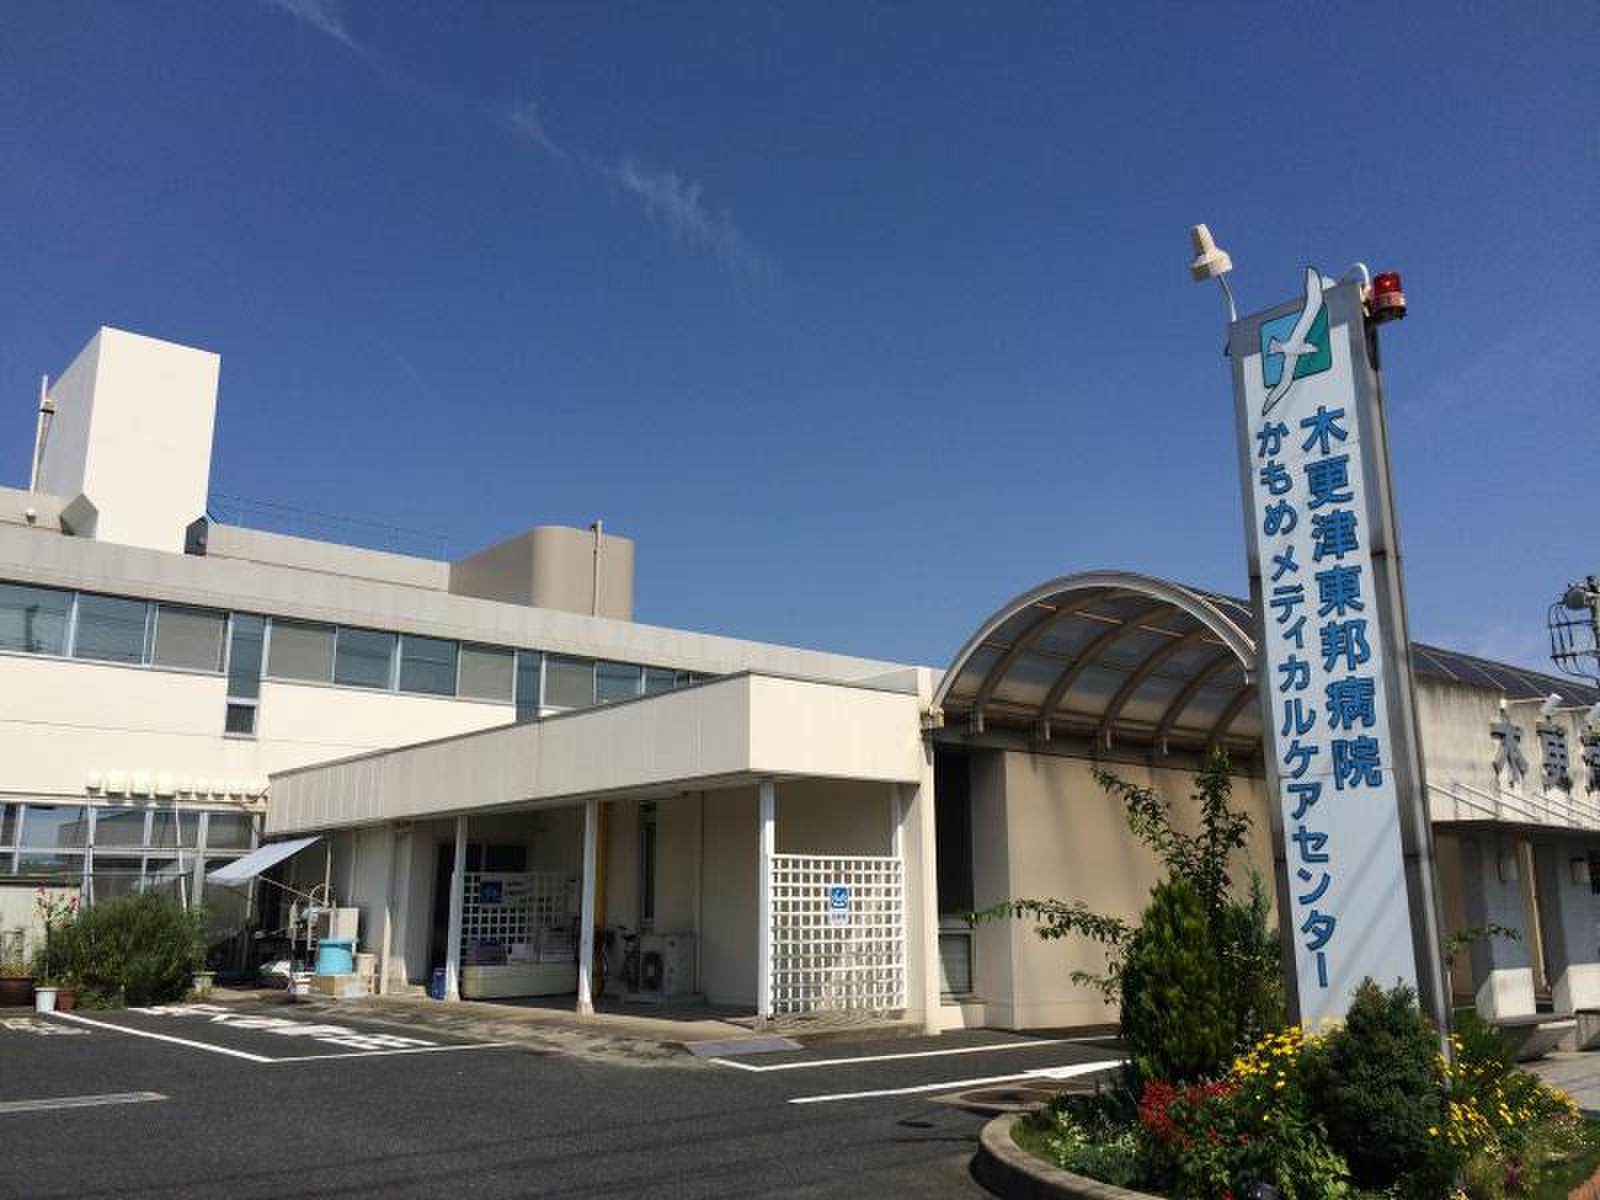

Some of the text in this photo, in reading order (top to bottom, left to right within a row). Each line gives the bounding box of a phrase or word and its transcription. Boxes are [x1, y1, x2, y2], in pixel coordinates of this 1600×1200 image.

[1256, 421, 1336, 988] かもめメディカルケアセンター
[1301, 405, 1382, 791] 木更津東邦病院
